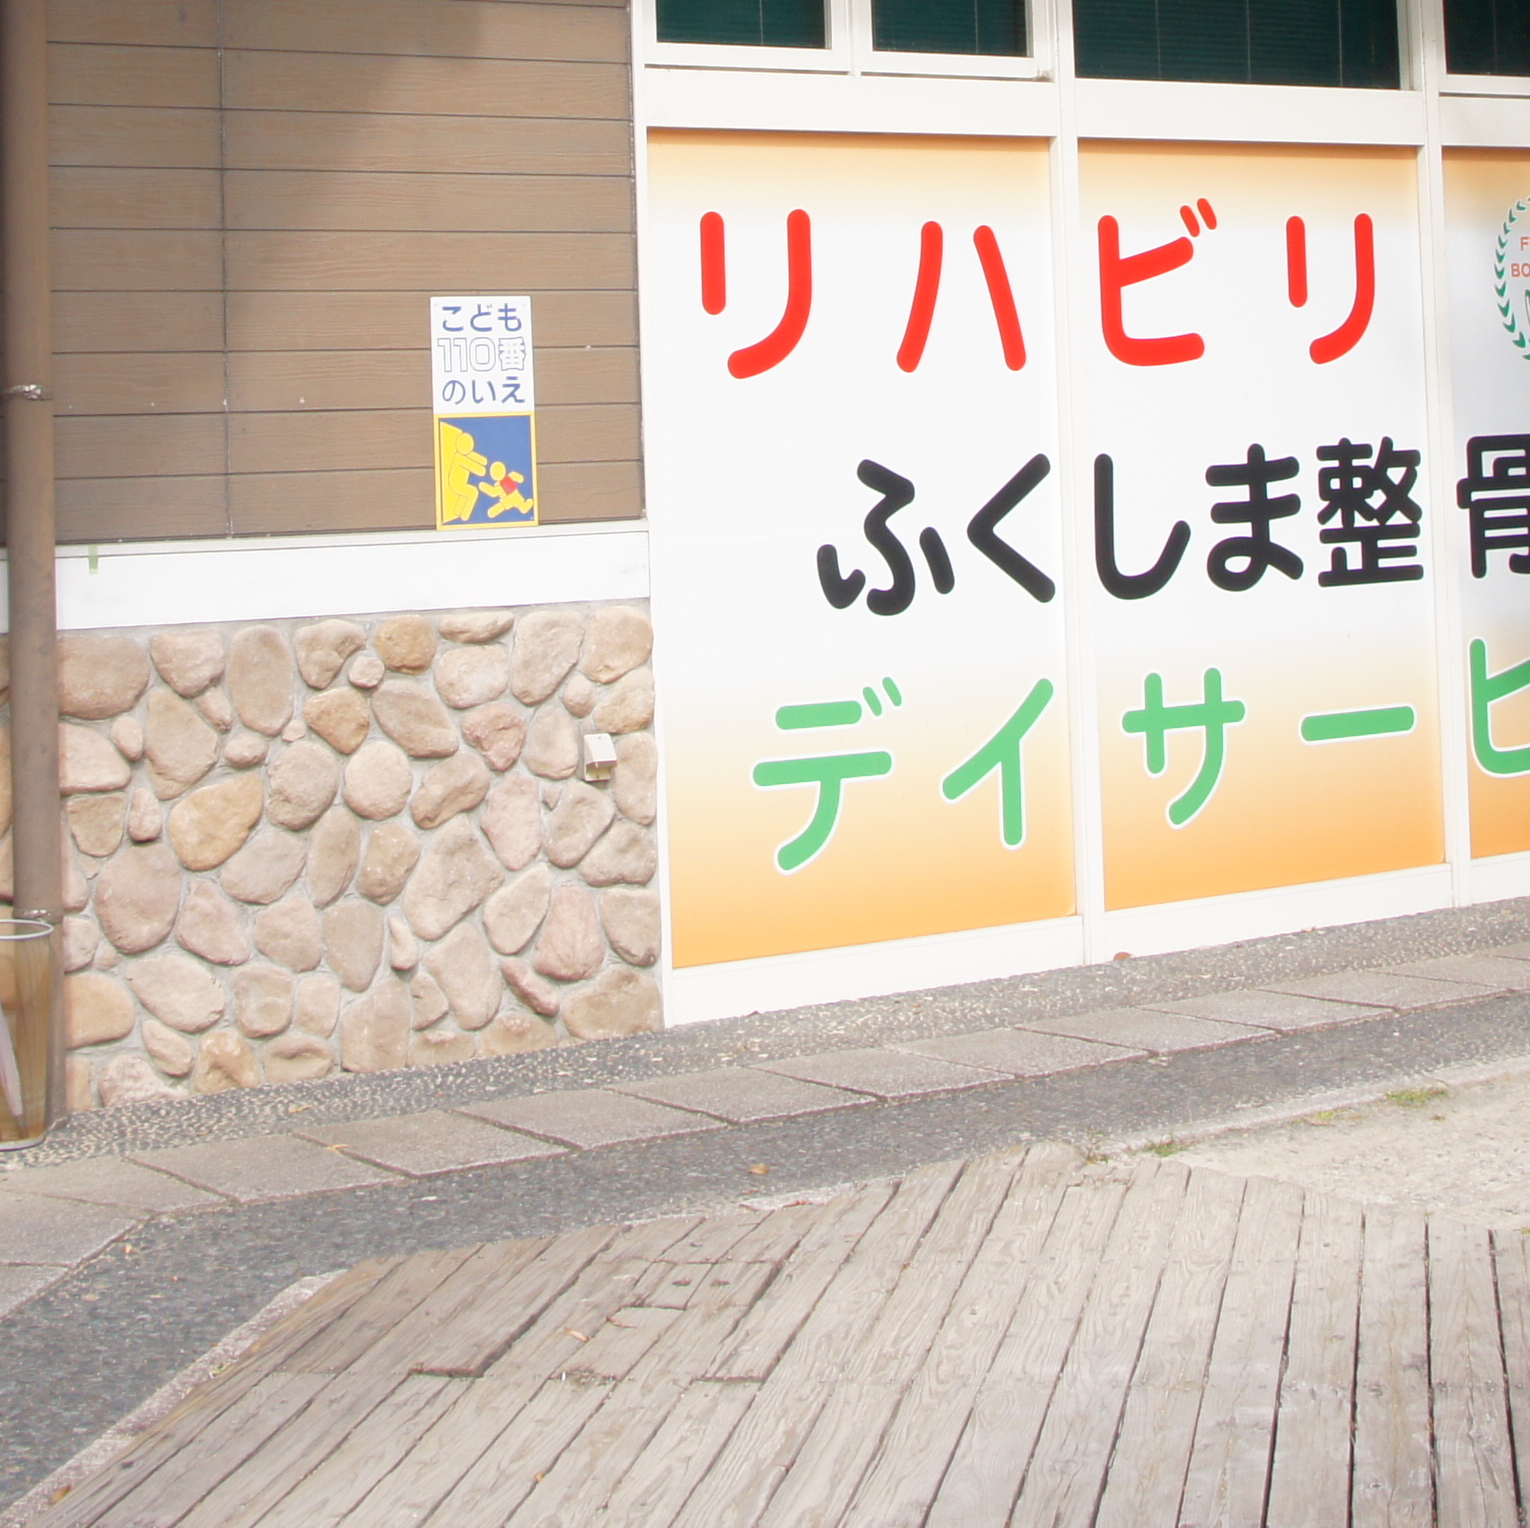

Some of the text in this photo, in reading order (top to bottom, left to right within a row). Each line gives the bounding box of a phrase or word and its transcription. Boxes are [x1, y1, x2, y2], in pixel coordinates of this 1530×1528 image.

[699, 197, 1376, 380] リハビリ
[441, 302, 522, 333] こども
[437, 336, 527, 373] 110番
[442, 375, 526, 405] のいえ
